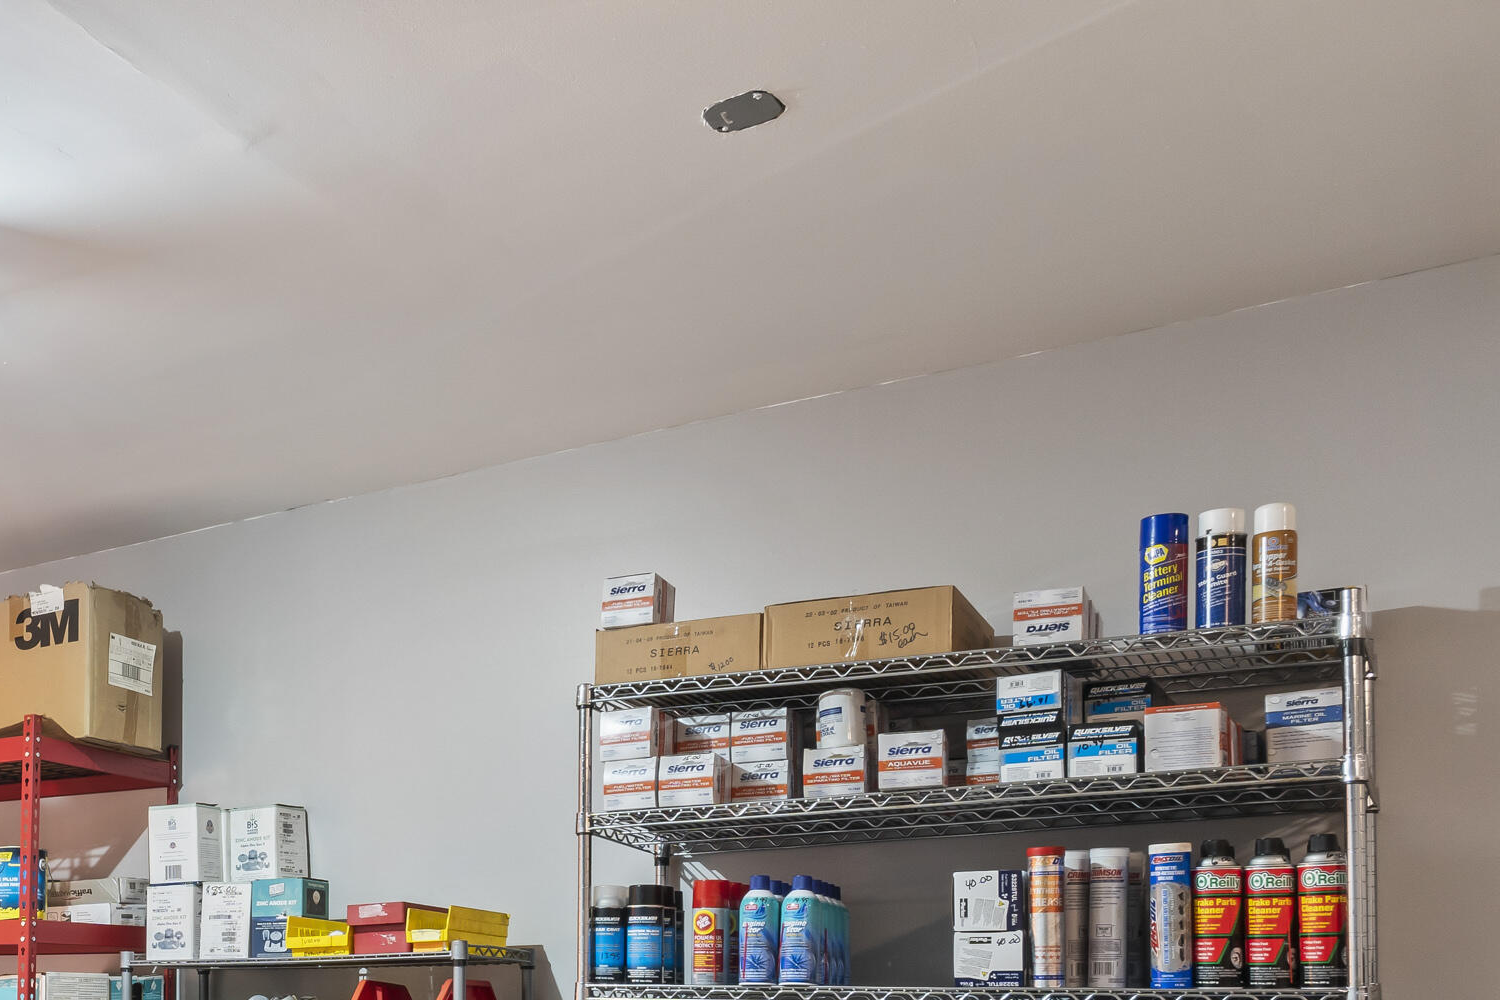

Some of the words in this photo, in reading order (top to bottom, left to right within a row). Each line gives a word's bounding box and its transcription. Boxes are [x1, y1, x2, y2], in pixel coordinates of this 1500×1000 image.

[1144, 563, 1178, 582] Battery
[1144, 573, 1183, 592] Terminal
[1143, 585, 1178, 604] Cleaner
[15, 599, 79, 650] 3M
[834, 616, 892, 631] SIERRA
[650, 645, 700, 658] SIERRA
[1074, 725, 1134, 736] QUICKSILVER
[1196, 874, 1240, 889] O'Reilly
[1216, 898, 1236, 906] Parts
[1248, 898, 1269, 906] Brake
[1270, 898, 1292, 906] Parts
[1301, 896, 1323, 904] Brake
